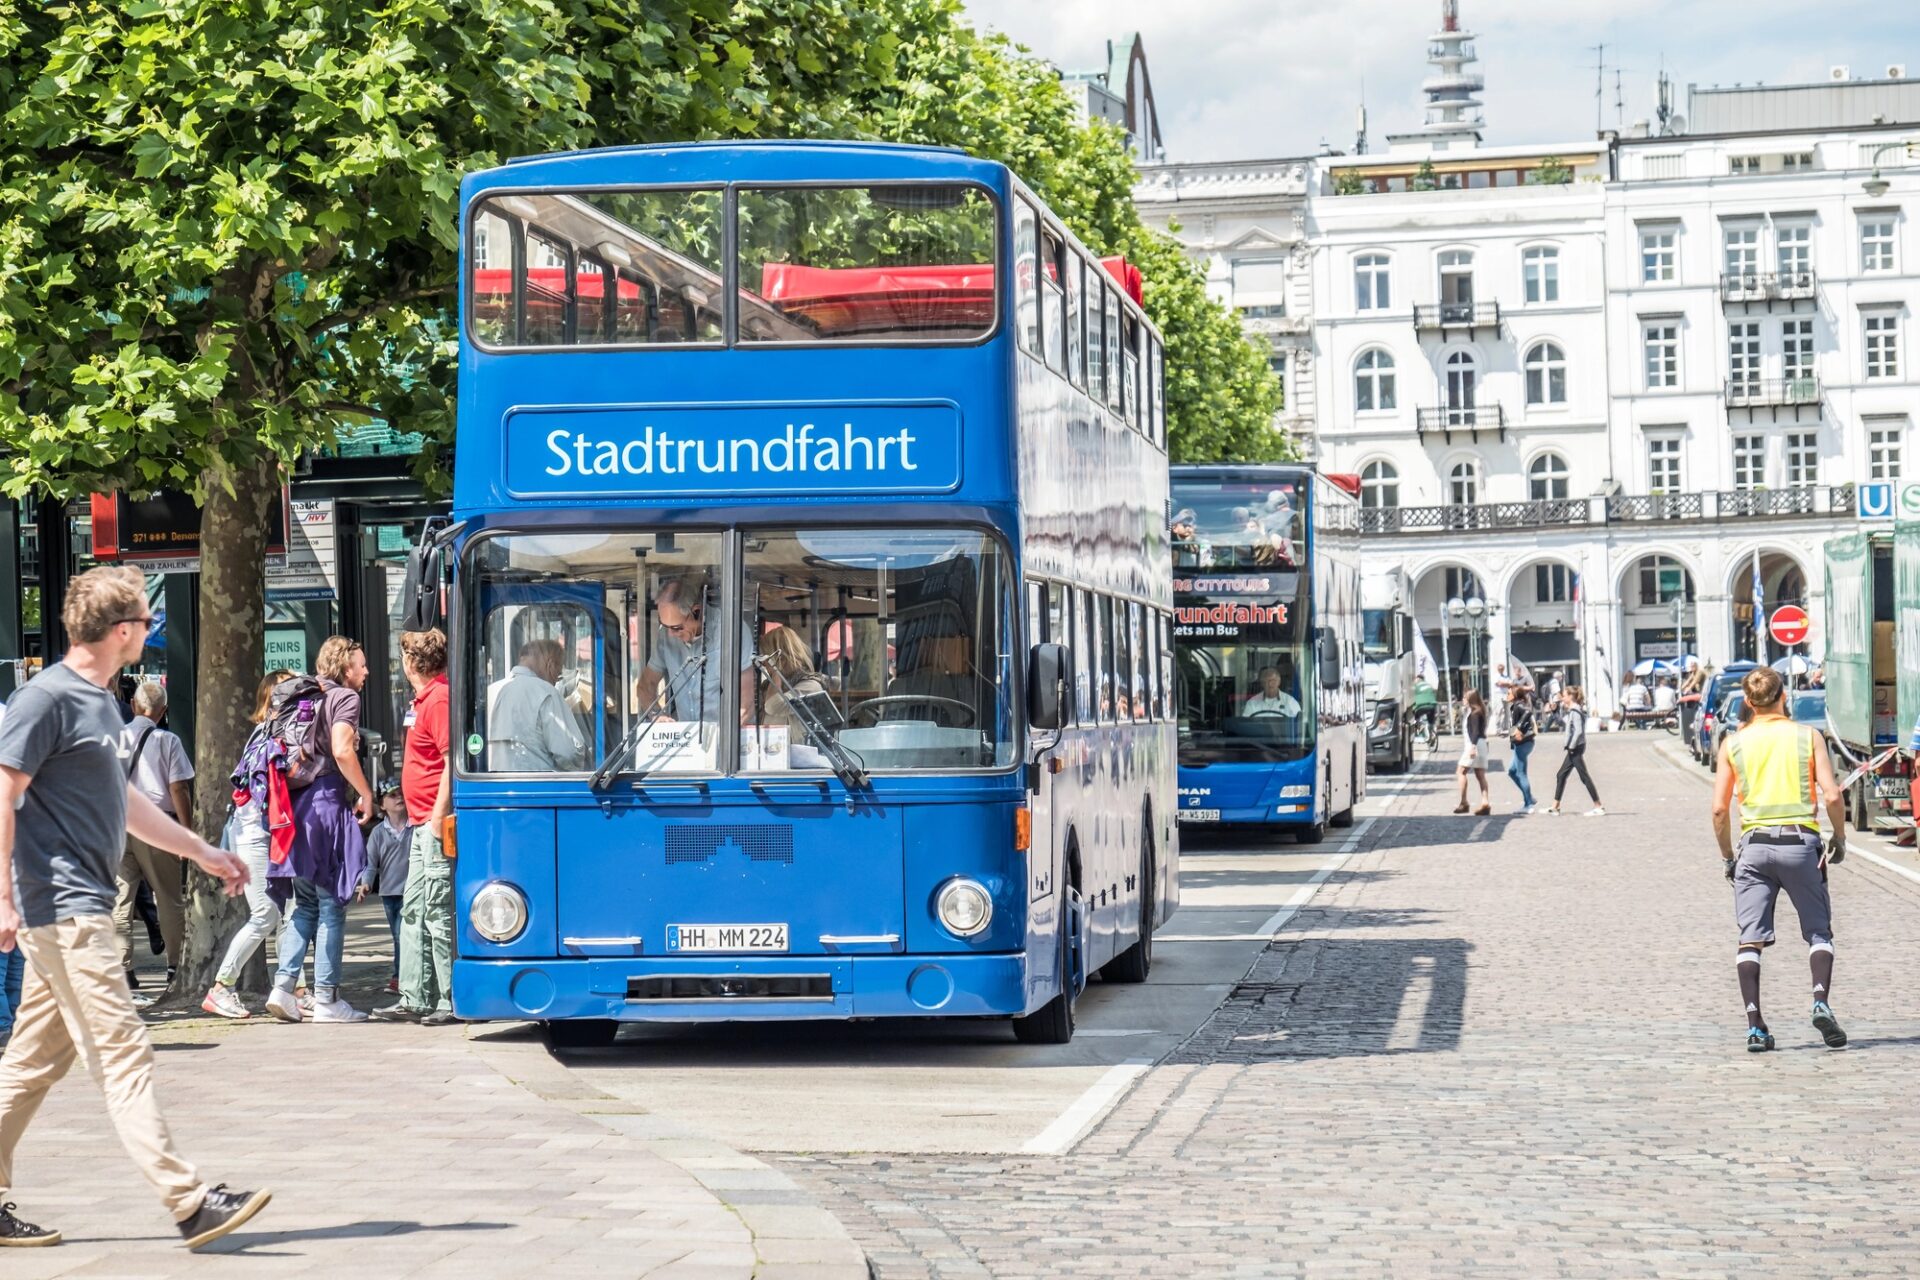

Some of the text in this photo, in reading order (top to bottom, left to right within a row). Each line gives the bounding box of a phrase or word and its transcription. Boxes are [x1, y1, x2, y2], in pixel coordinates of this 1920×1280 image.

[545, 423, 918, 476] Stadtrundfahrt
[291, 500, 319, 510] markt
[1862, 485, 1889, 515] U
[1173, 601, 1288, 624] rundfahrt
[1174, 624, 1239, 636] ets am Bus
[264, 641, 301, 653] VENIRS
[264, 658, 302, 671] VENIRS
[652, 731, 692, 740] LINIE C
[680, 928, 705, 947] HH
[719, 928, 744, 947] MM
[749, 926, 786, 949] 224
